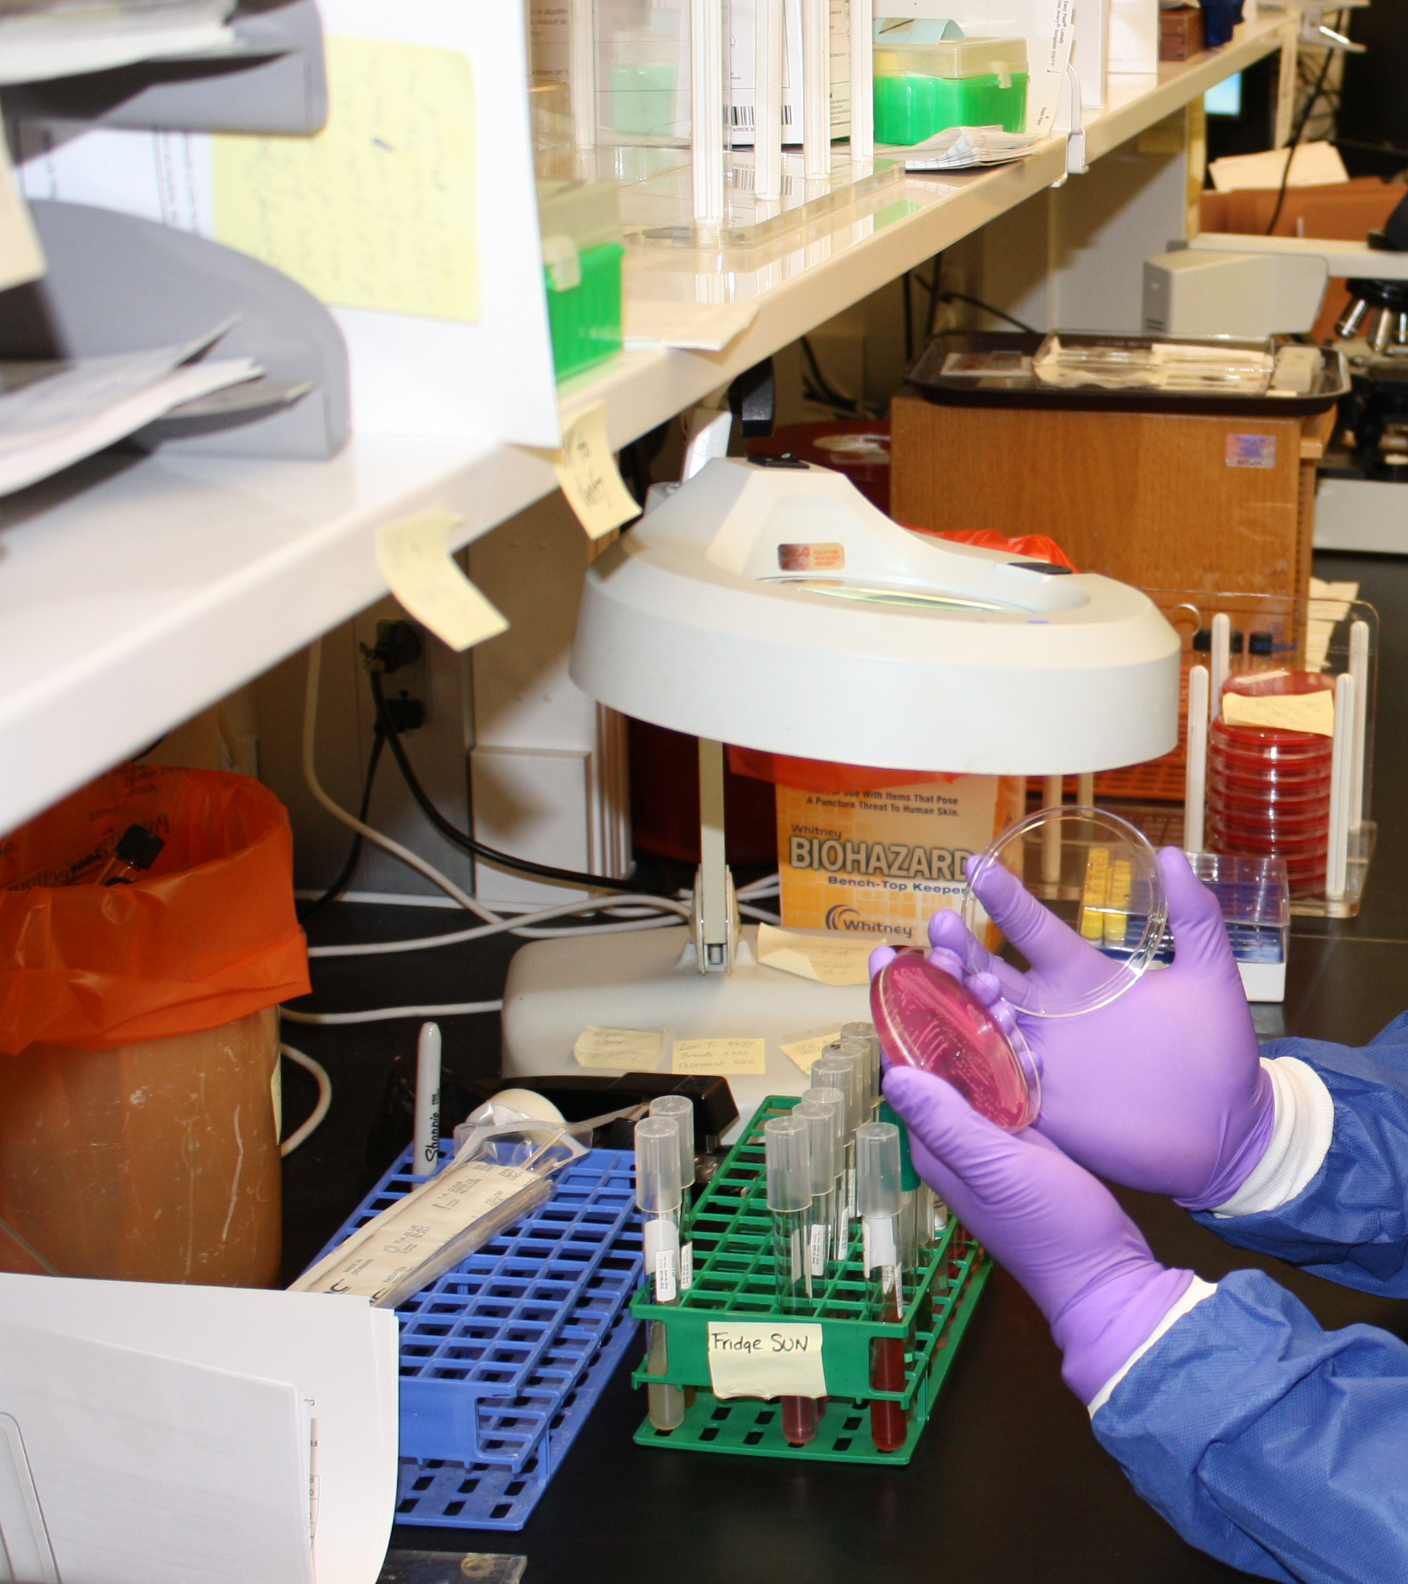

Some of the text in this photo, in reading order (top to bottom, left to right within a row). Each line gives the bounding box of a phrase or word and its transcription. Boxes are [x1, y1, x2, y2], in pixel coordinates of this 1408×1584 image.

[815, 797, 855, 809] Puncture
[859, 801, 887, 811] Threat
[890, 804, 900, 812] To
[903, 805, 934, 815] Human
[937, 808, 960, 817] Skin.
[862, 790, 883, 799] With
[886, 792, 911, 801] Items
[914, 794, 934, 803] That
[937, 796, 958, 805] Pose
[791, 824, 842, 839] Whitney
[789, 836, 973, 882] BIOHAZARD
[828, 876, 907, 891] Bench-Top
[843, 919, 913, 938] Whitney
[711, 1332, 808, 1354] Fridge SUN
